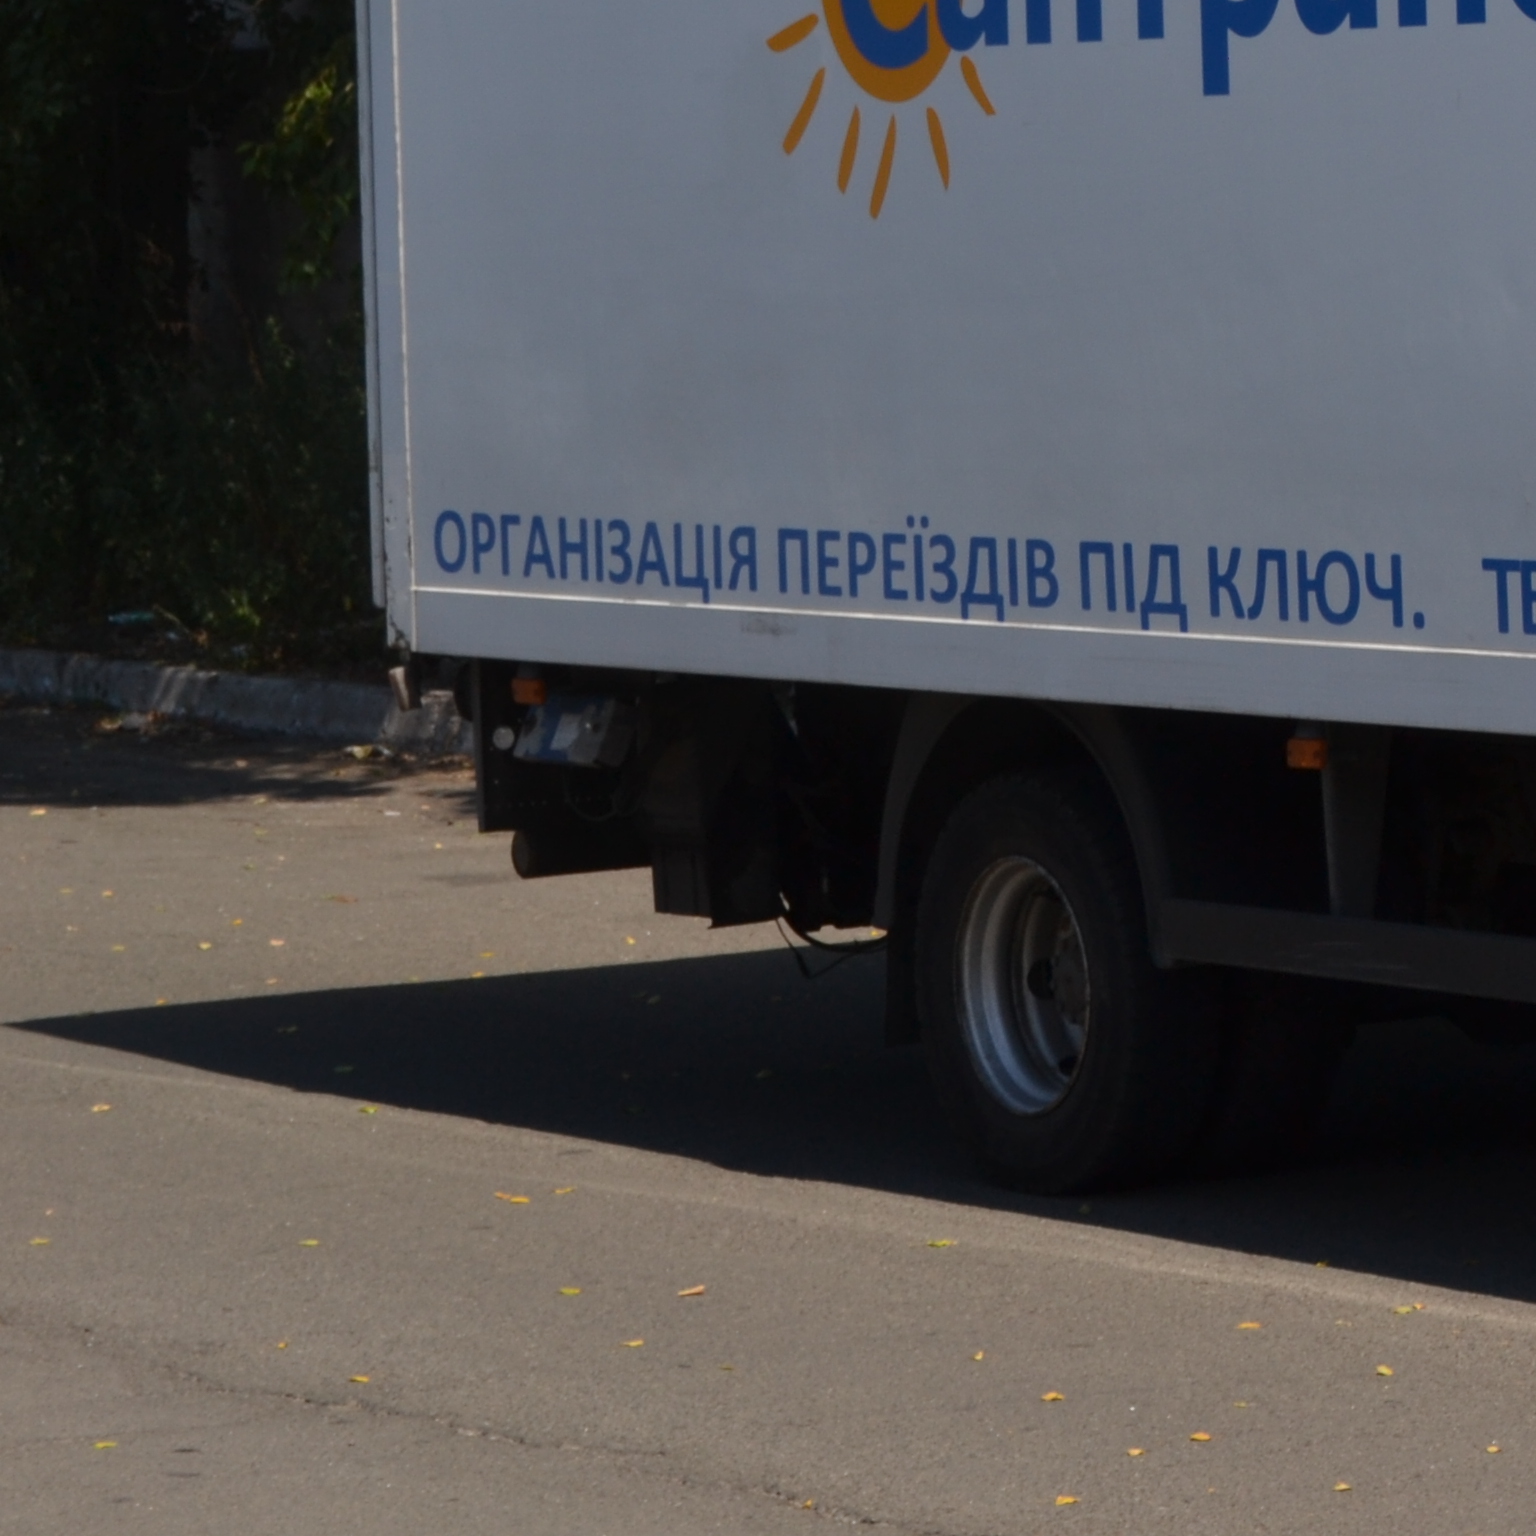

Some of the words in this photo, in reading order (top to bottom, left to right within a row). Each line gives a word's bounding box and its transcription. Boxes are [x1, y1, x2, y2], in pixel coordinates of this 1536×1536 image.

[433, 509, 759, 605] ОРГАНІЗАЦІЯ
[777, 515, 1060, 623] ПЕРЕЇЗДІВ
[1079, 541, 1188, 633] ПІД
[1207, 546, 1426, 630] КЛЮЧ.
